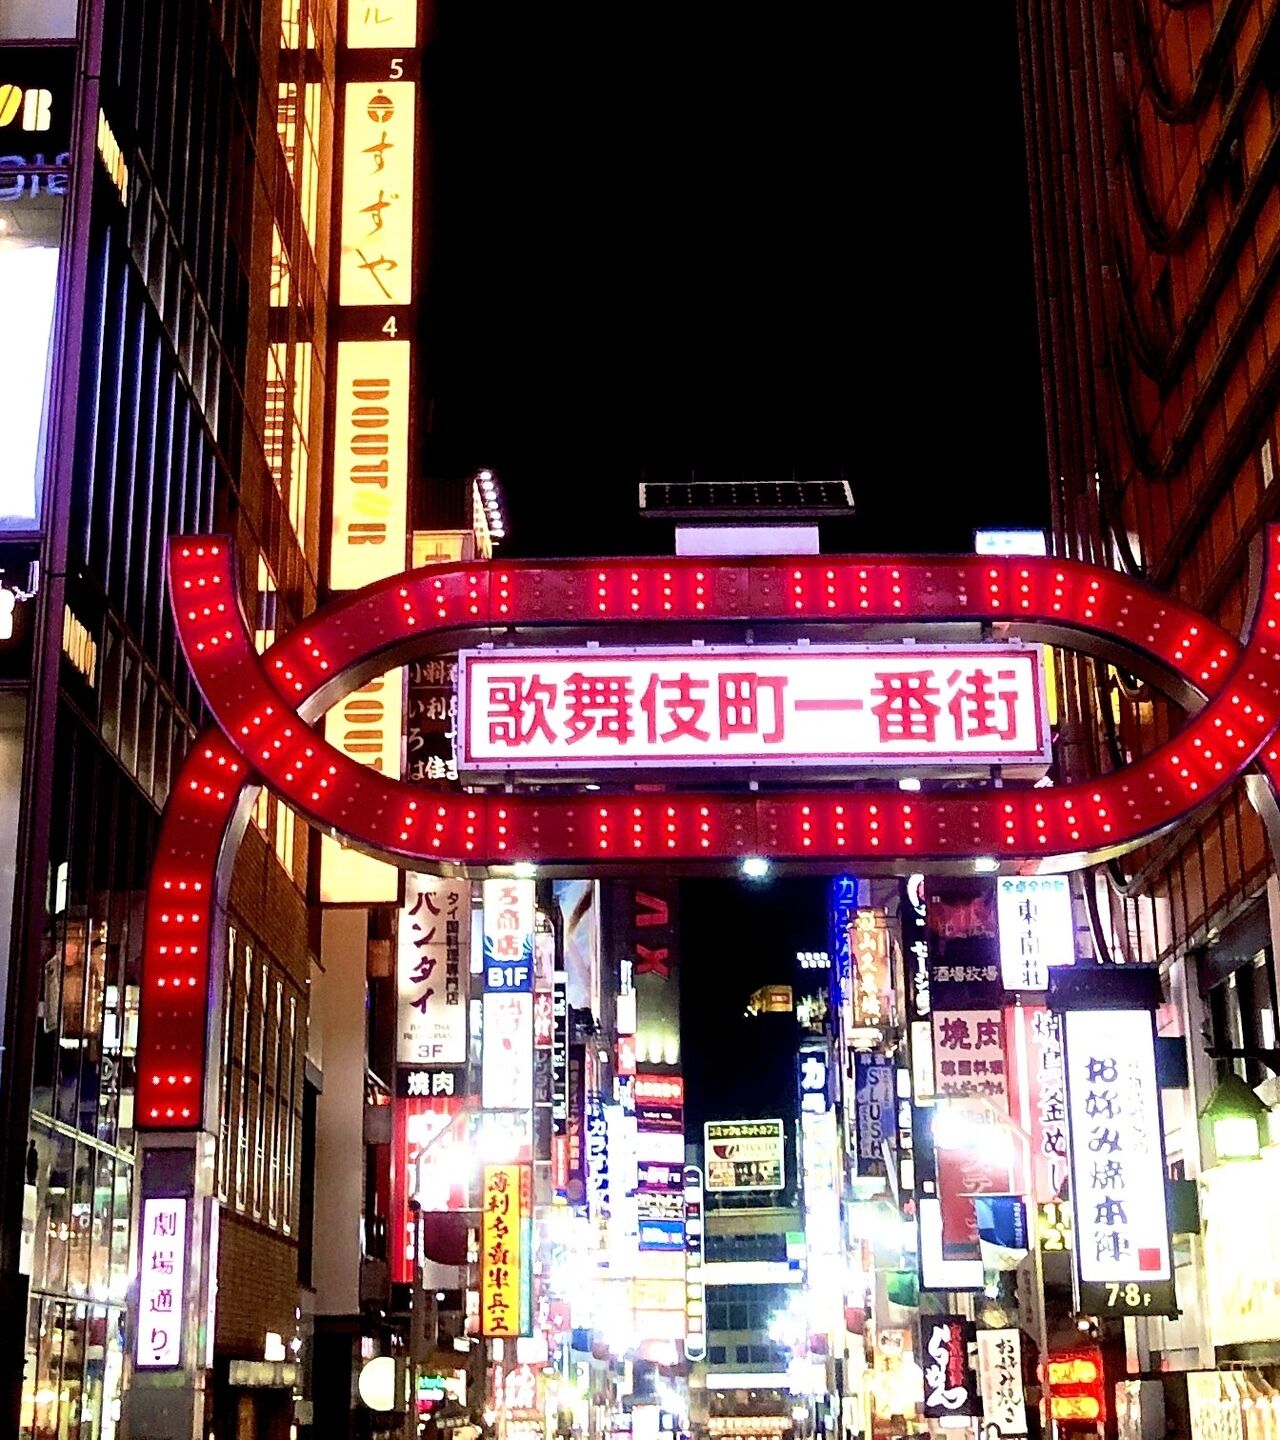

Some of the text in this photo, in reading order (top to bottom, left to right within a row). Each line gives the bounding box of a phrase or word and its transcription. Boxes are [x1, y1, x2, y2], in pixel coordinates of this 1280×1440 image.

[388, 59, 404, 78] 5
[357, 130, 400, 298] すずや
[382, 316, 398, 339] 4
[347, 377, 391, 546] DOUTOR
[486, 668, 1019, 745] 歌舞伎町一番街
[408, 892, 440, 1014] バンタイ
[487, 967, 528, 987] B1F
[418, 1044, 443, 1058] 3F
[408, 1071, 455, 1096] 焼肉
[149, 1211, 177, 1361] 劇場通り
